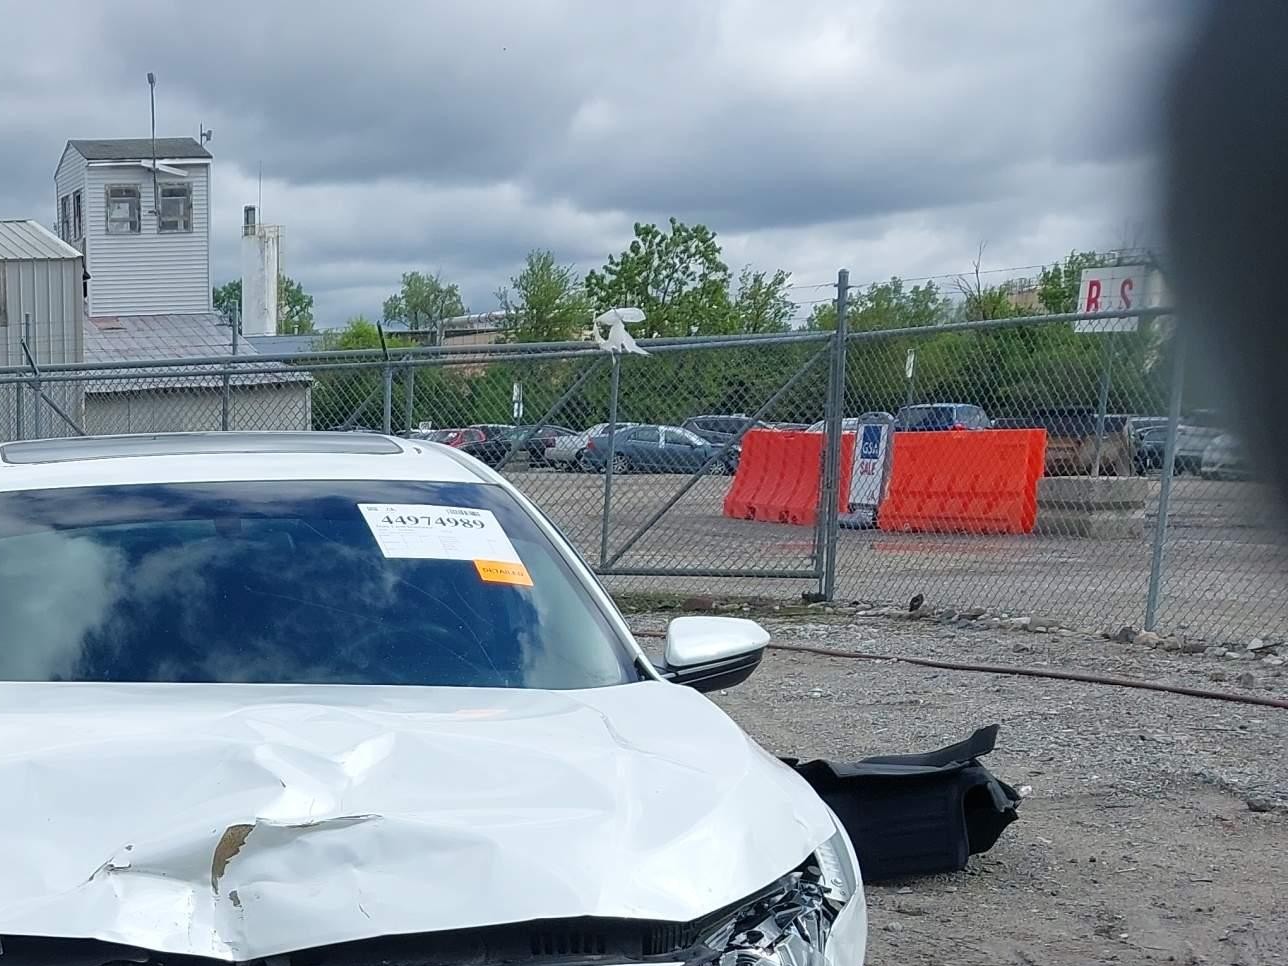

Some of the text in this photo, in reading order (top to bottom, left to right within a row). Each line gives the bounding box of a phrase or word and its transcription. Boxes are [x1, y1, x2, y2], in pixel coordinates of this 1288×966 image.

[862, 440, 879, 454] GSA
[859, 460, 876, 476] SALE
[381, 514, 486, 529] 44974989
